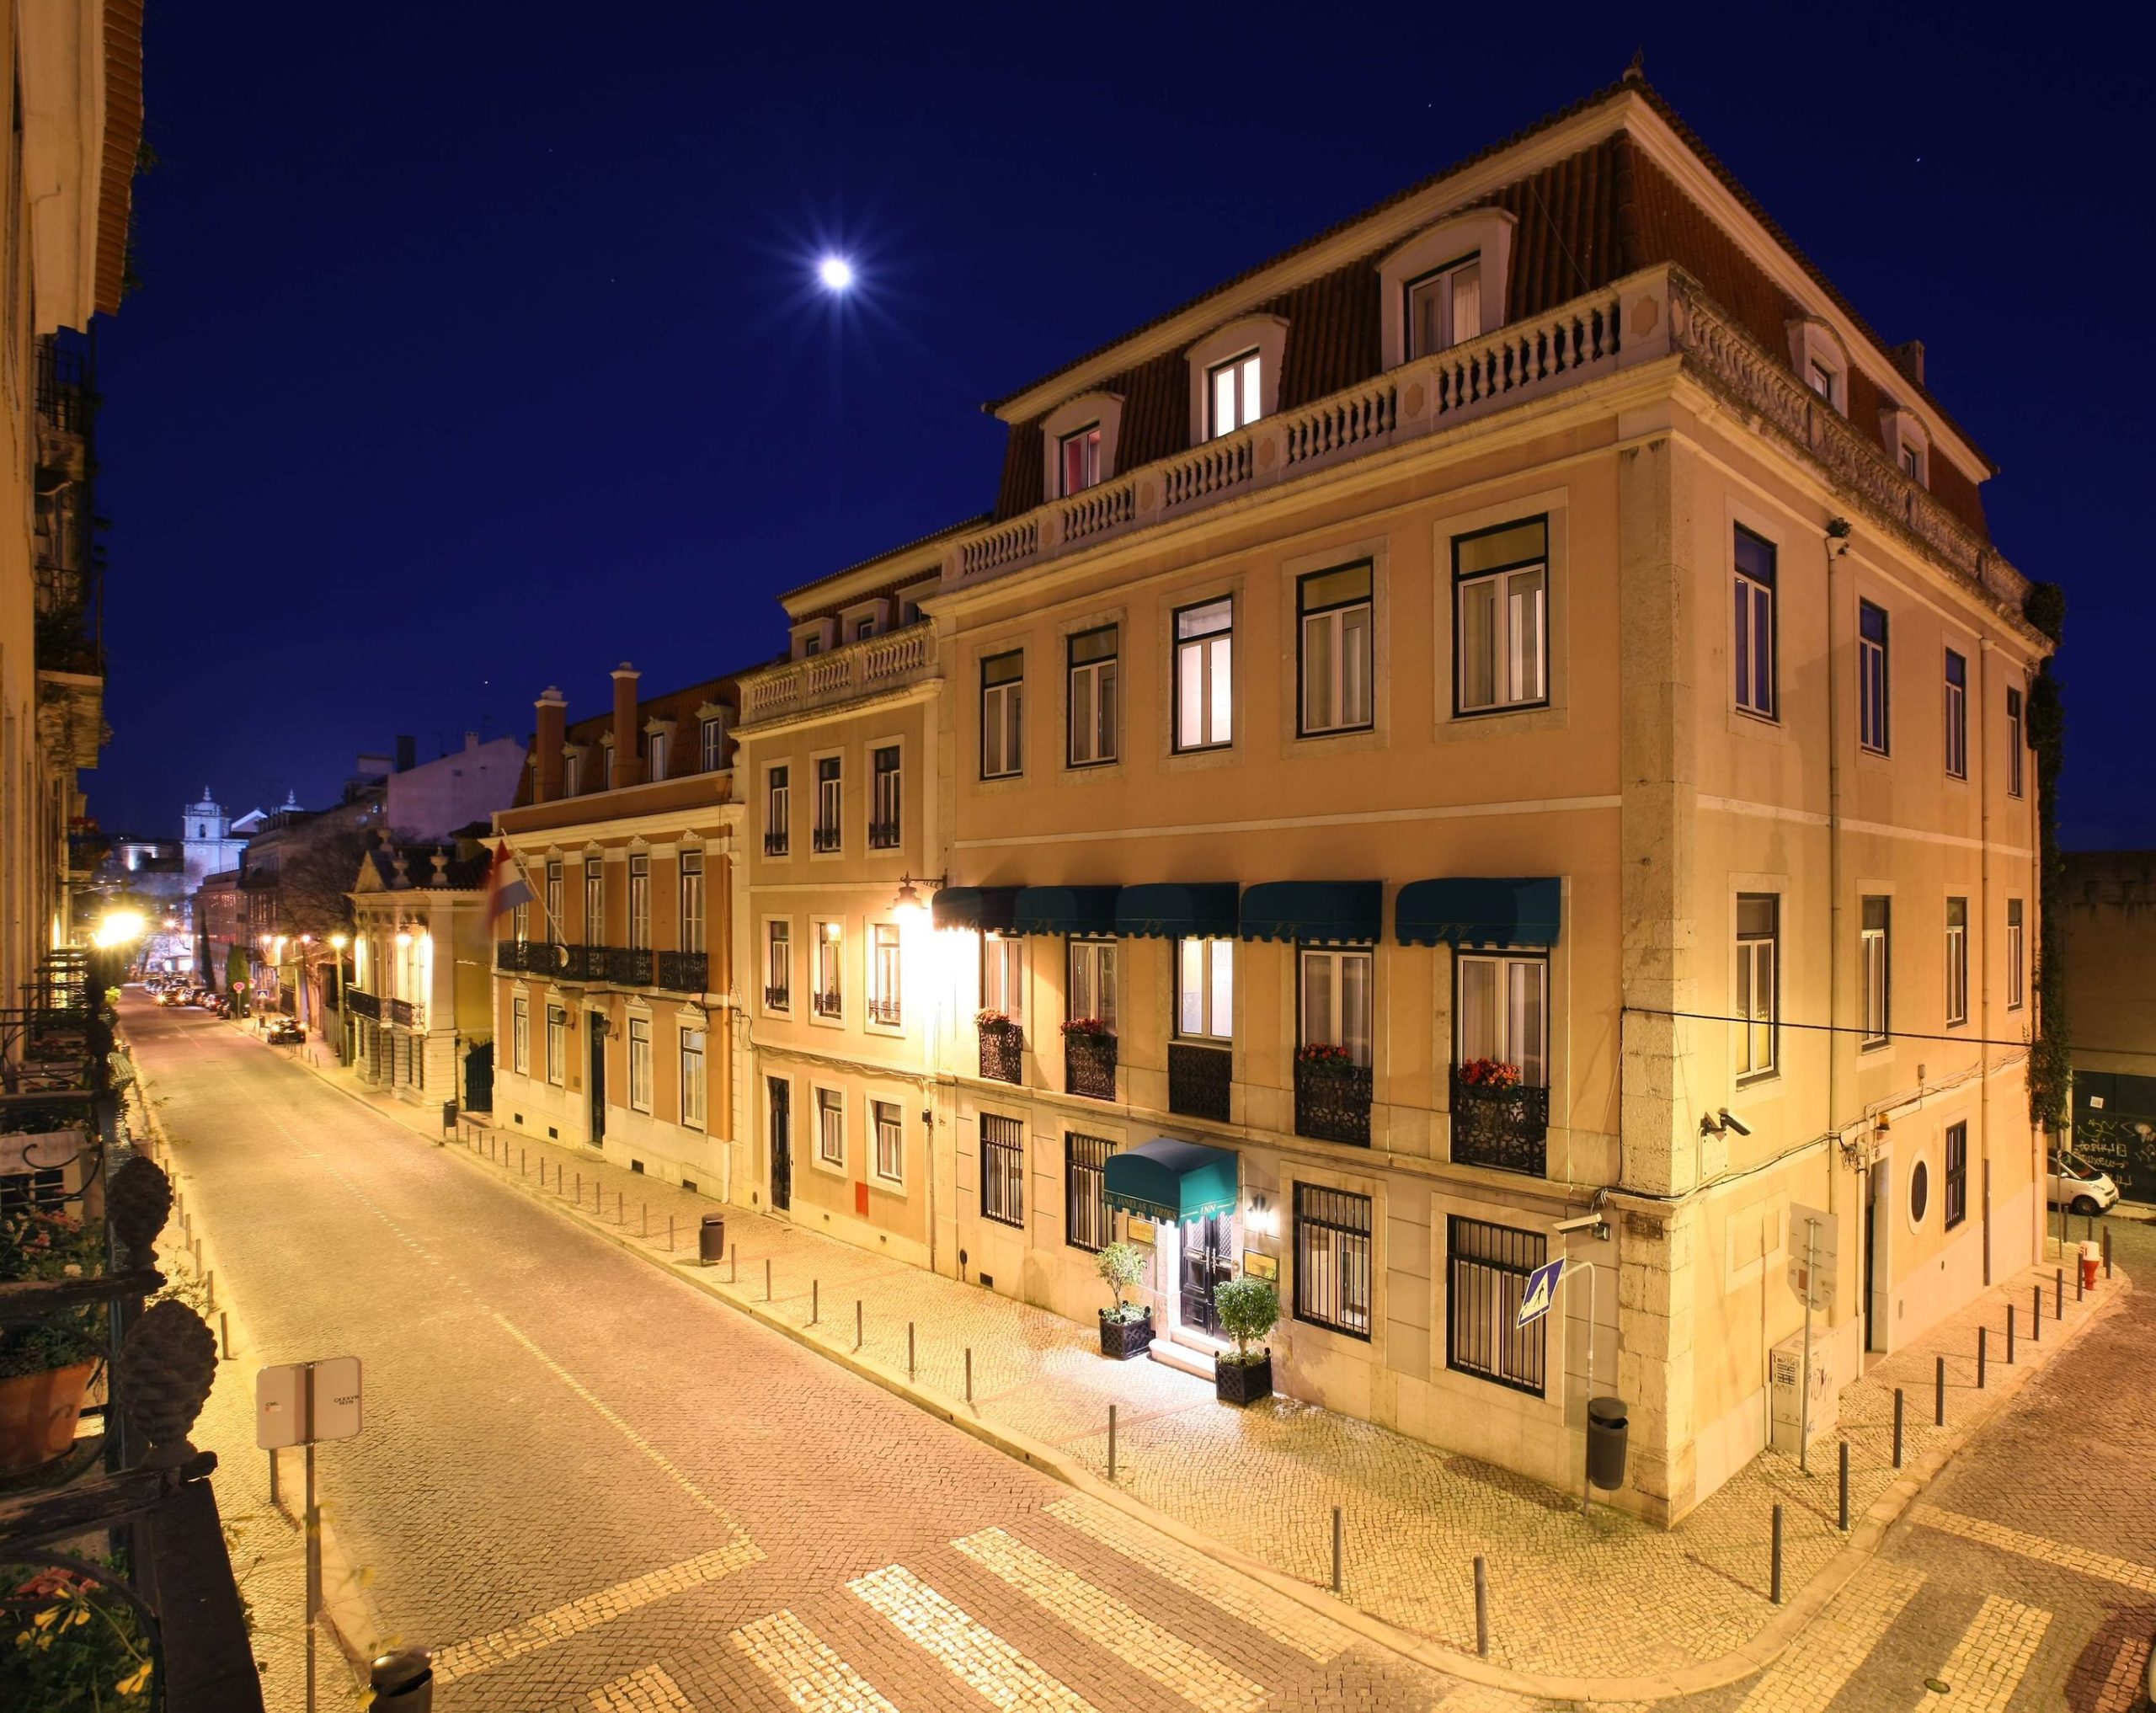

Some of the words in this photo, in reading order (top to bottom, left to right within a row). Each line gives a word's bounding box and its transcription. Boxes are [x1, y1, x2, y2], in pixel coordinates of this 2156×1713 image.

[1118, 1197, 1146, 1211] JANELAS
[1150, 1204, 1177, 1220] VERDES
[1200, 1203, 1217, 1214] INN
